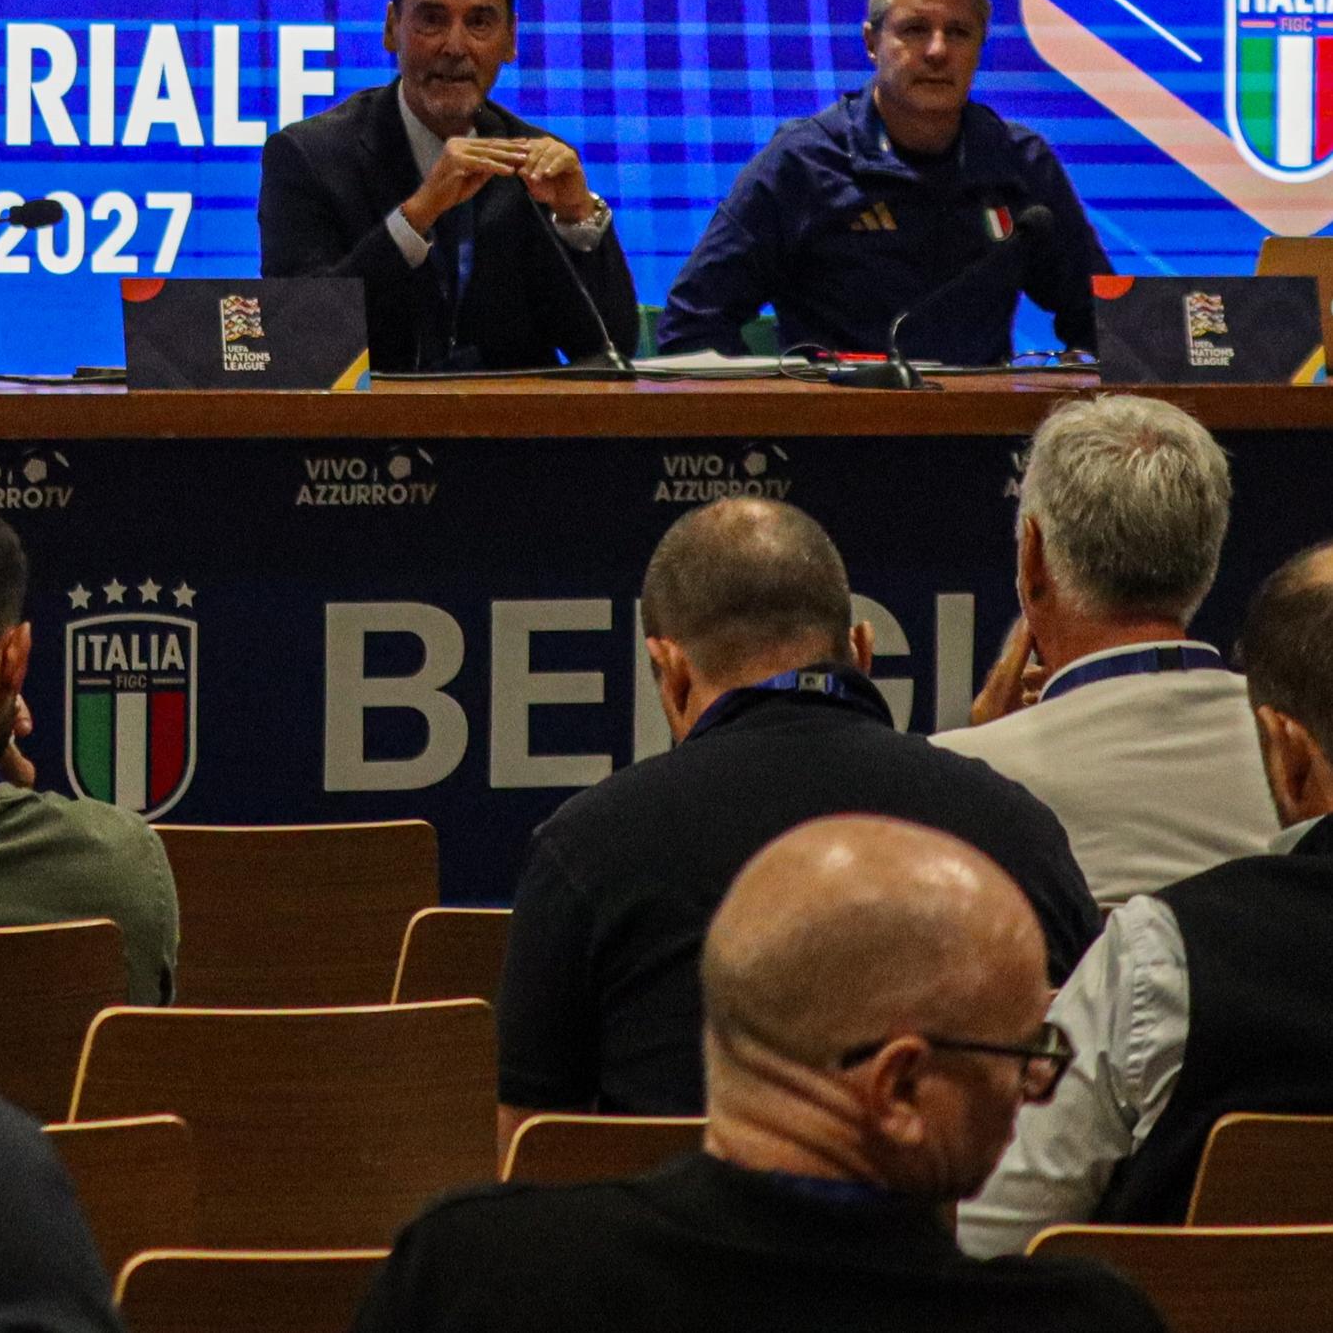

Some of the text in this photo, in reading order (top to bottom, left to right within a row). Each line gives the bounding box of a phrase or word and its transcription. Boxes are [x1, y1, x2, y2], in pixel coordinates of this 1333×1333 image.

[224, 353, 271, 362] NATIONS
[1190, 348, 1235, 357] NATIONS
[224, 362, 266, 371] LEAGUE
[1190, 357, 1230, 366] LEAGUE
[305, 458, 367, 480] VIVO
[663, 454, 724, 477] VIVO
[77, 633, 185, 672] ITALIA
[116, 674, 147, 689] FIGC
